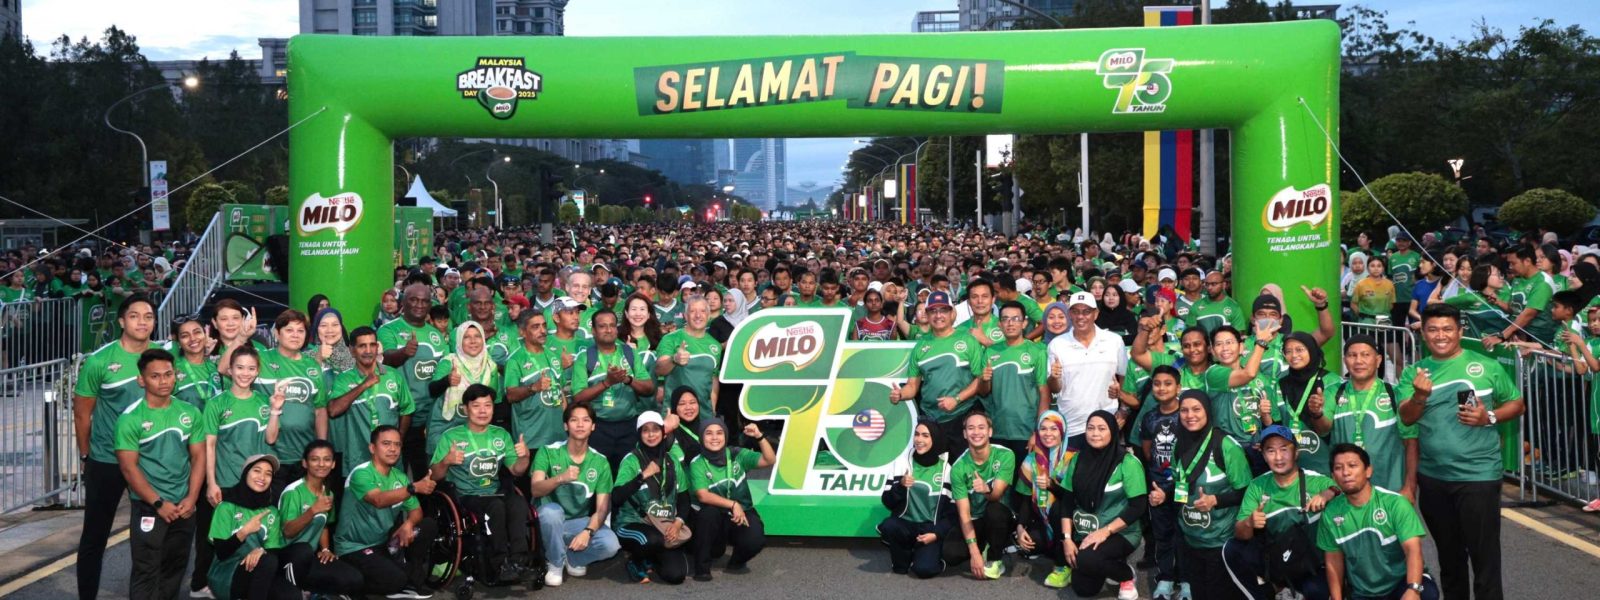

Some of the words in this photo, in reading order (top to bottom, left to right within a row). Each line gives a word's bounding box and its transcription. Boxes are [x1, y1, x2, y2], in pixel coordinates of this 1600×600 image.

[479, 58, 522, 66] MALAYSIA
[1110, 56, 1134, 66] MILO
[458, 67, 541, 90] BREAKFAST
[656, 55, 845, 112] SELAMAT
[868, 63, 988, 109] PAGI!
[303, 204, 357, 226] MILO
[1272, 196, 1328, 221] MILO
[322, 240, 347, 248] UNTUK
[1298, 234, 1321, 242] UNTUK
[1270, 243, 1315, 251] MELANGKAH
[786, 325, 815, 337] Nestlé
[754, 335, 817, 360] MILO
[820, 473, 886, 491] TAHU
